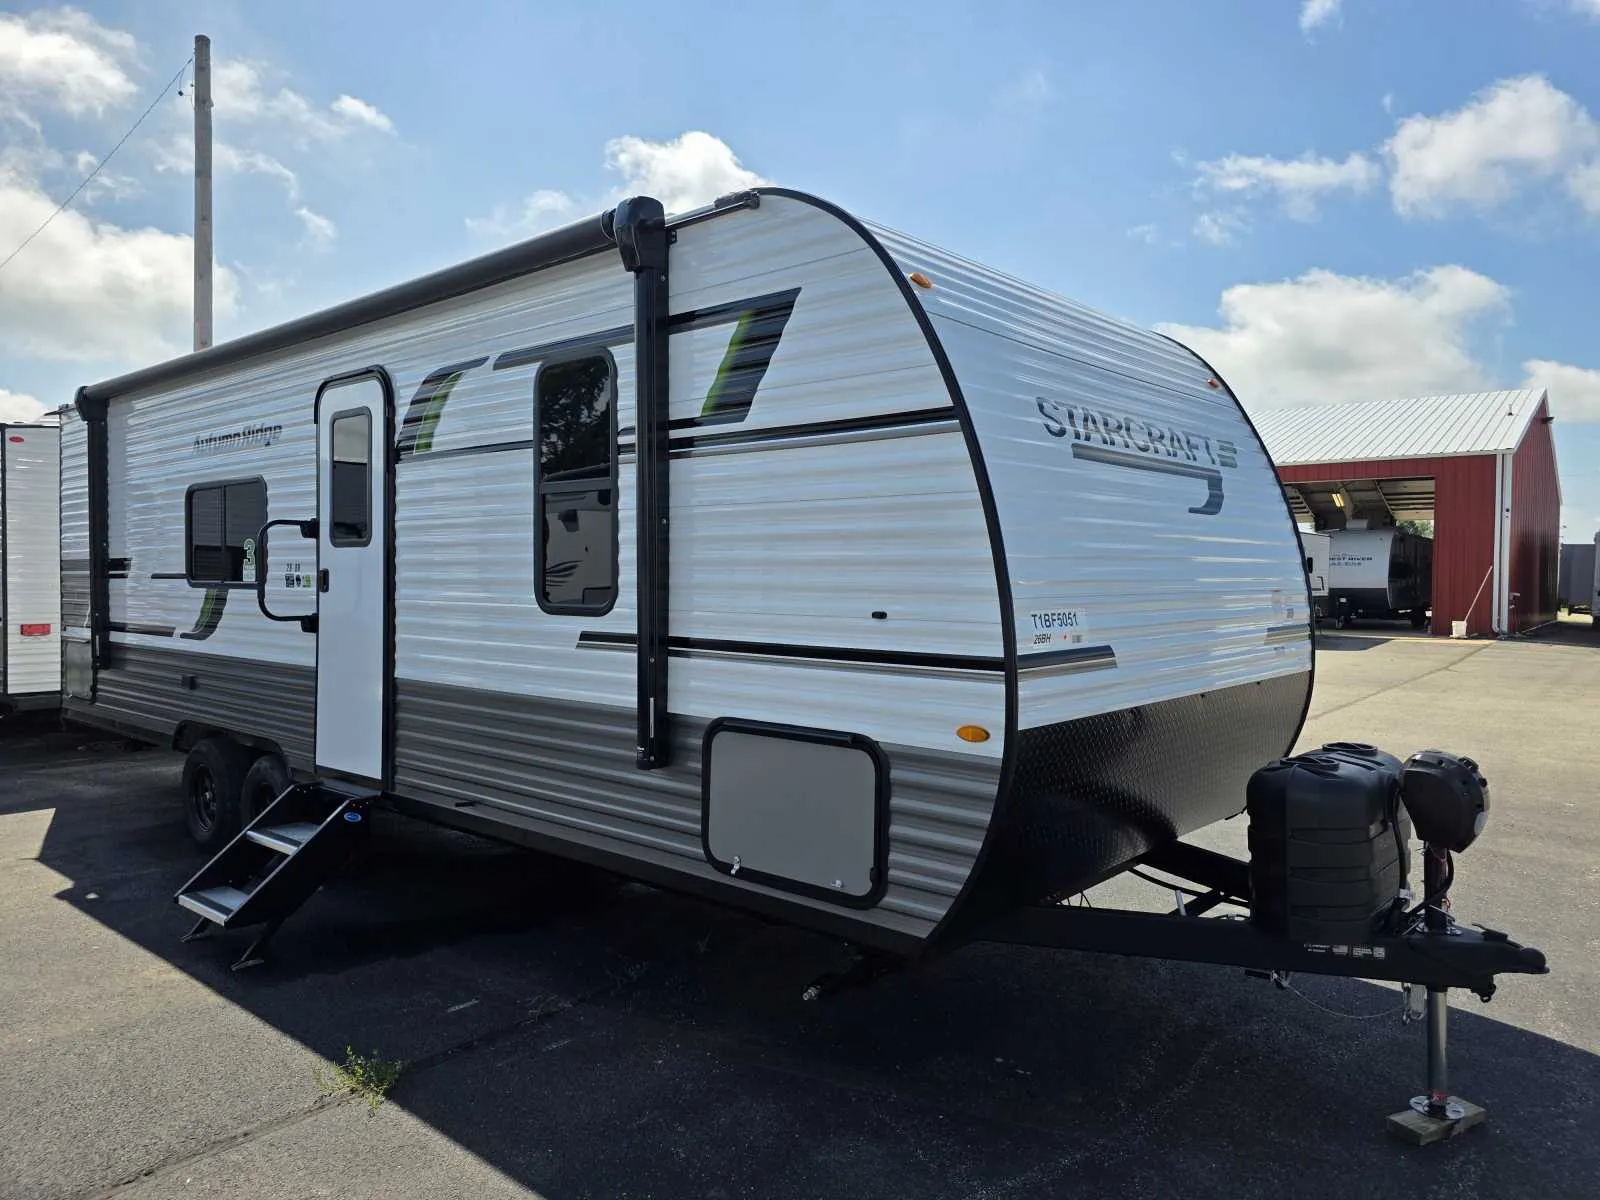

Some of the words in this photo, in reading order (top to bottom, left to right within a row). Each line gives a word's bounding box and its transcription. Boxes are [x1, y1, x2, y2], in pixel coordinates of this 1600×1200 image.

[1036, 396, 1216, 465] STARCRAFT
[243, 538, 256, 566] 3
[1031, 611, 1079, 630] T1BF5051
[1033, 633, 1052, 645] 26BH
